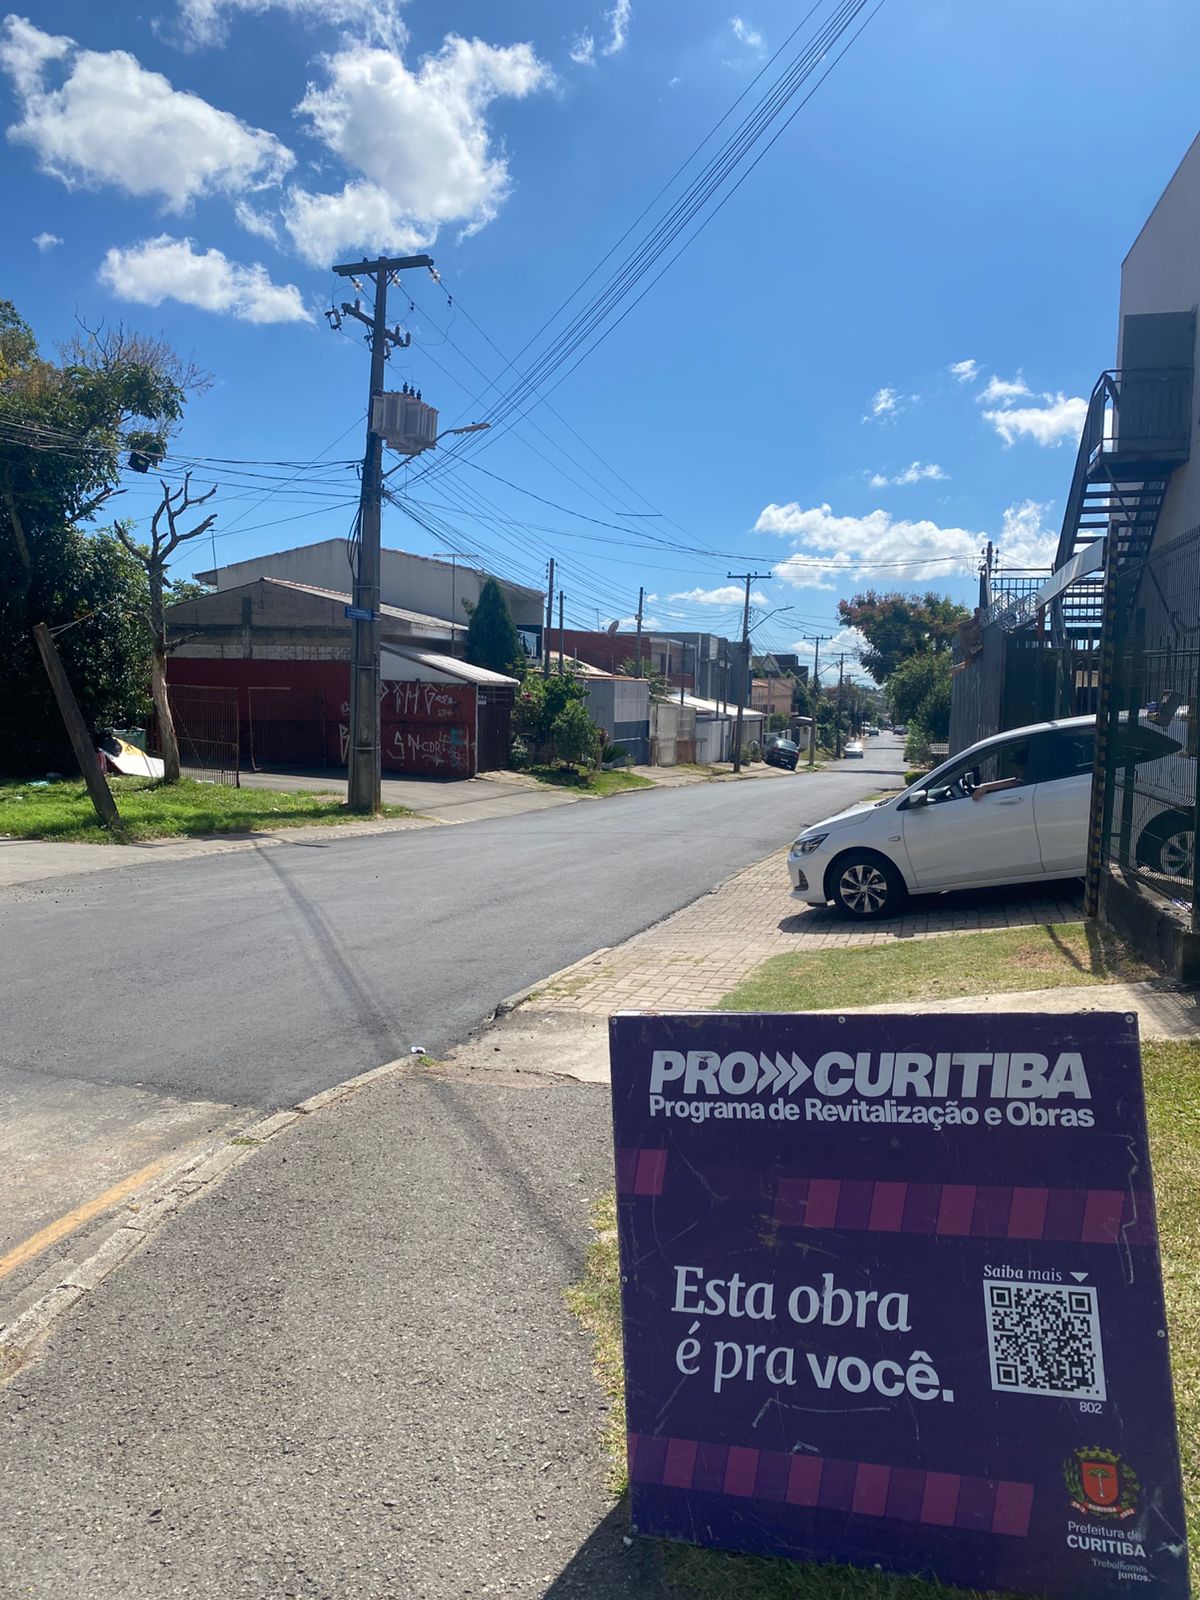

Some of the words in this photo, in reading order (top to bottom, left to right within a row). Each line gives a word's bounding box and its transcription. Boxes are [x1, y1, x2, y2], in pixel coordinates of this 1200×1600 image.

[650, 1051, 759, 1096] PRO
[814, 1052, 1092, 1099] CURITIBA
[650, 1095, 765, 1123] Programa
[769, 1098, 800, 1120] de
[805, 1098, 979, 1131] Revitalização
[984, 1107, 1002, 1124] e
[1006, 1101, 1095, 1127] Obras
[984, 1264, 1024, 1279] Saiba
[1028, 1268, 1062, 1281] mais
[671, 1265, 776, 1320] Esta
[788, 1273, 912, 1332] obra
[676, 1320, 701, 1375] é
[713, 1340, 796, 1393] pra
[806, 1350, 954, 1402] você.
[1079, 1401, 1103, 1414] 802
[1068, 1521, 1124, 1539] Prefeitura
[1127, 1529, 1141, 1541] de
[1067, 1535, 1146, 1558] CURITIBA
[1092, 1558, 1148, 1573] Trabalhamos
